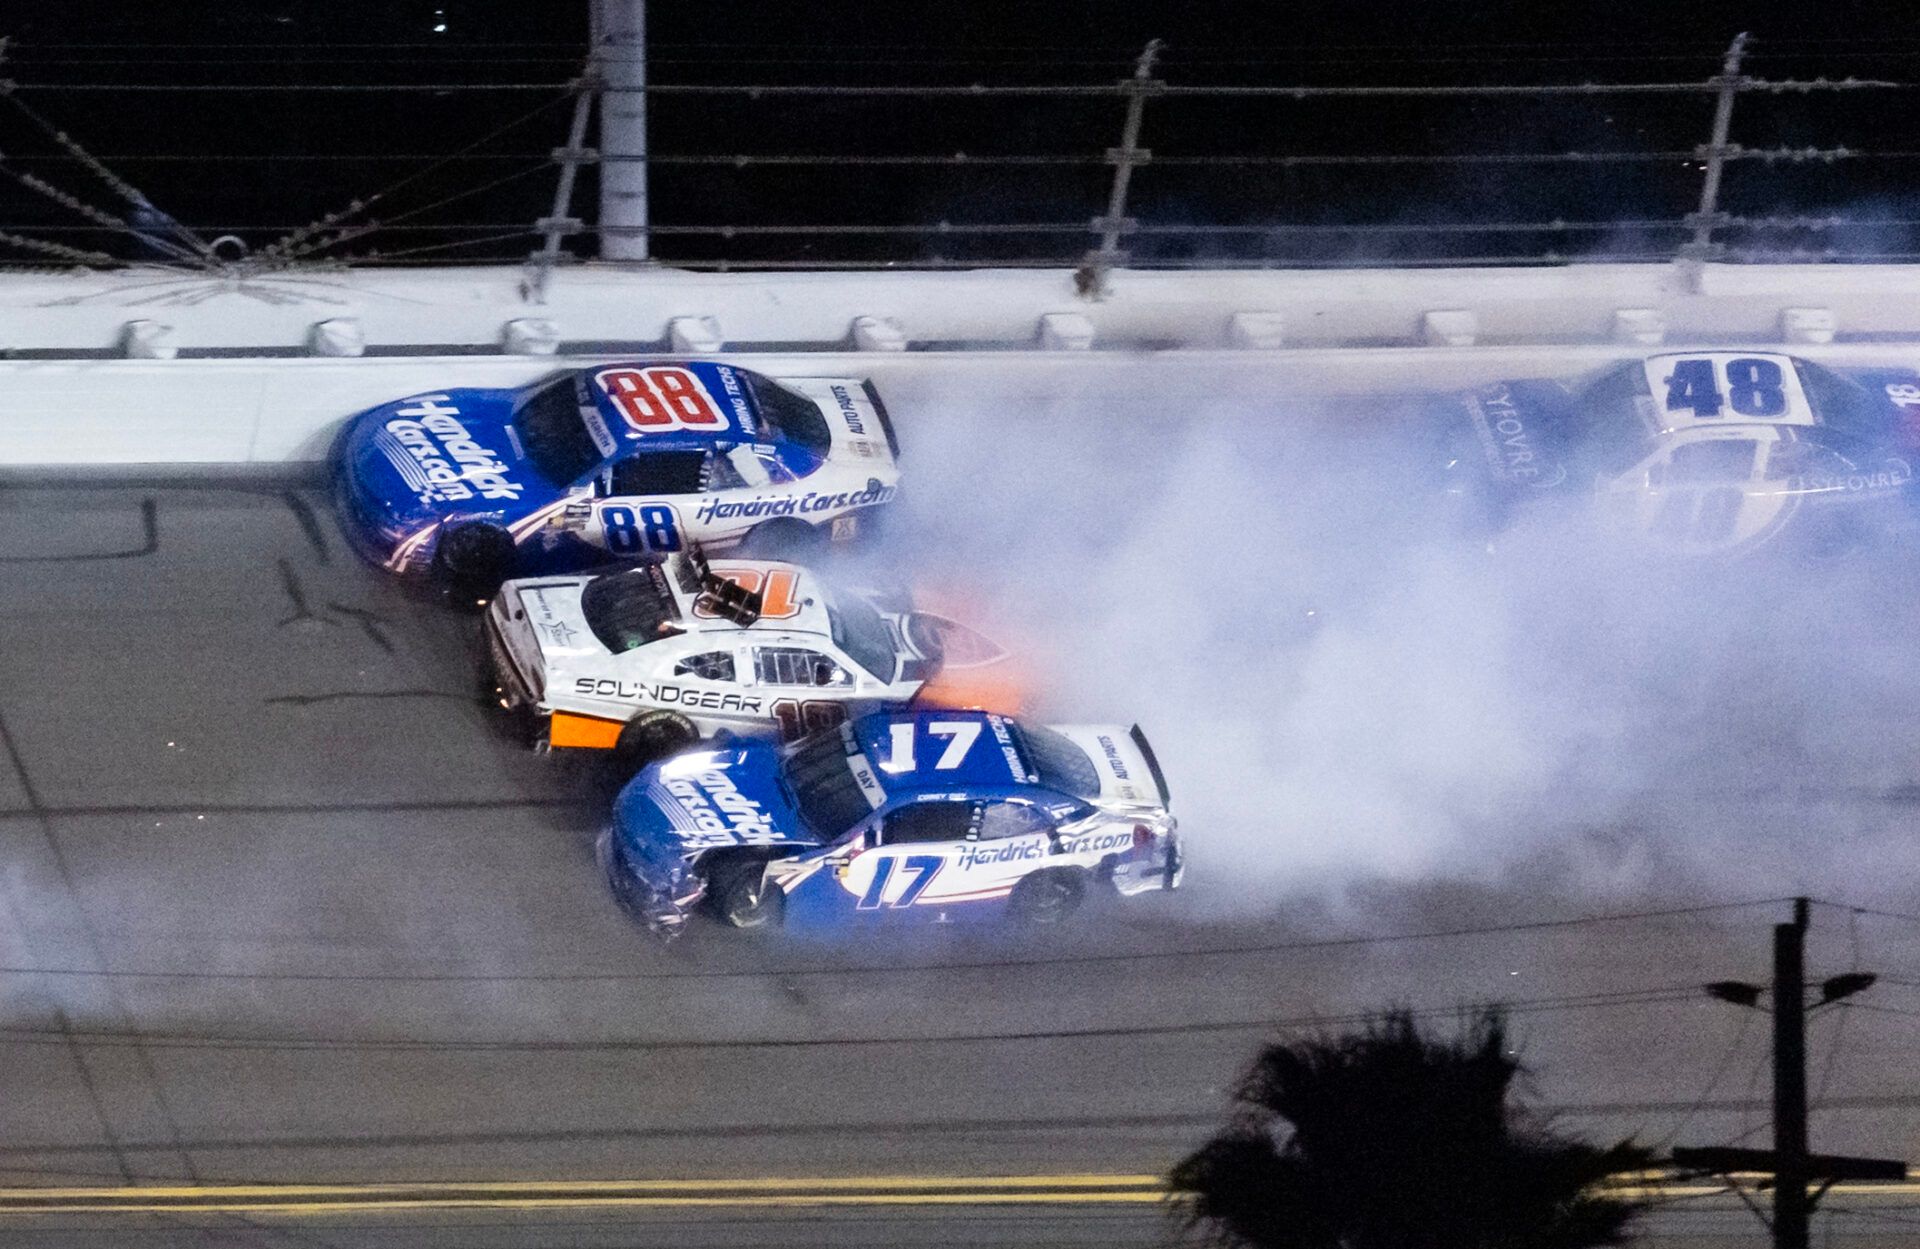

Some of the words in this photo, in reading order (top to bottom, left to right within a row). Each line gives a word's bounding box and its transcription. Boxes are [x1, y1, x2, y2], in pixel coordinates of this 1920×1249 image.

[597, 368, 727, 431] 88
[716, 366, 741, 398] TECHS
[831, 384, 855, 410] PARTS
[1665, 358, 1785, 417] 48
[733, 399, 757, 435] HIRING
[842, 408, 866, 435] AUTO
[385, 419, 473, 502] Cars.com
[396, 395, 524, 502] Hendrick
[601, 505, 682, 553] 88
[575, 677, 762, 714] SOUNDGEAR
[879, 721, 982, 774] 17
[1001, 748, 1025, 783] HIRING
[1098, 735, 1120, 760] PARTS
[857, 769, 875, 791] DAY
[1110, 756, 1131, 781] AUTO
[857, 855, 948, 910] 17
